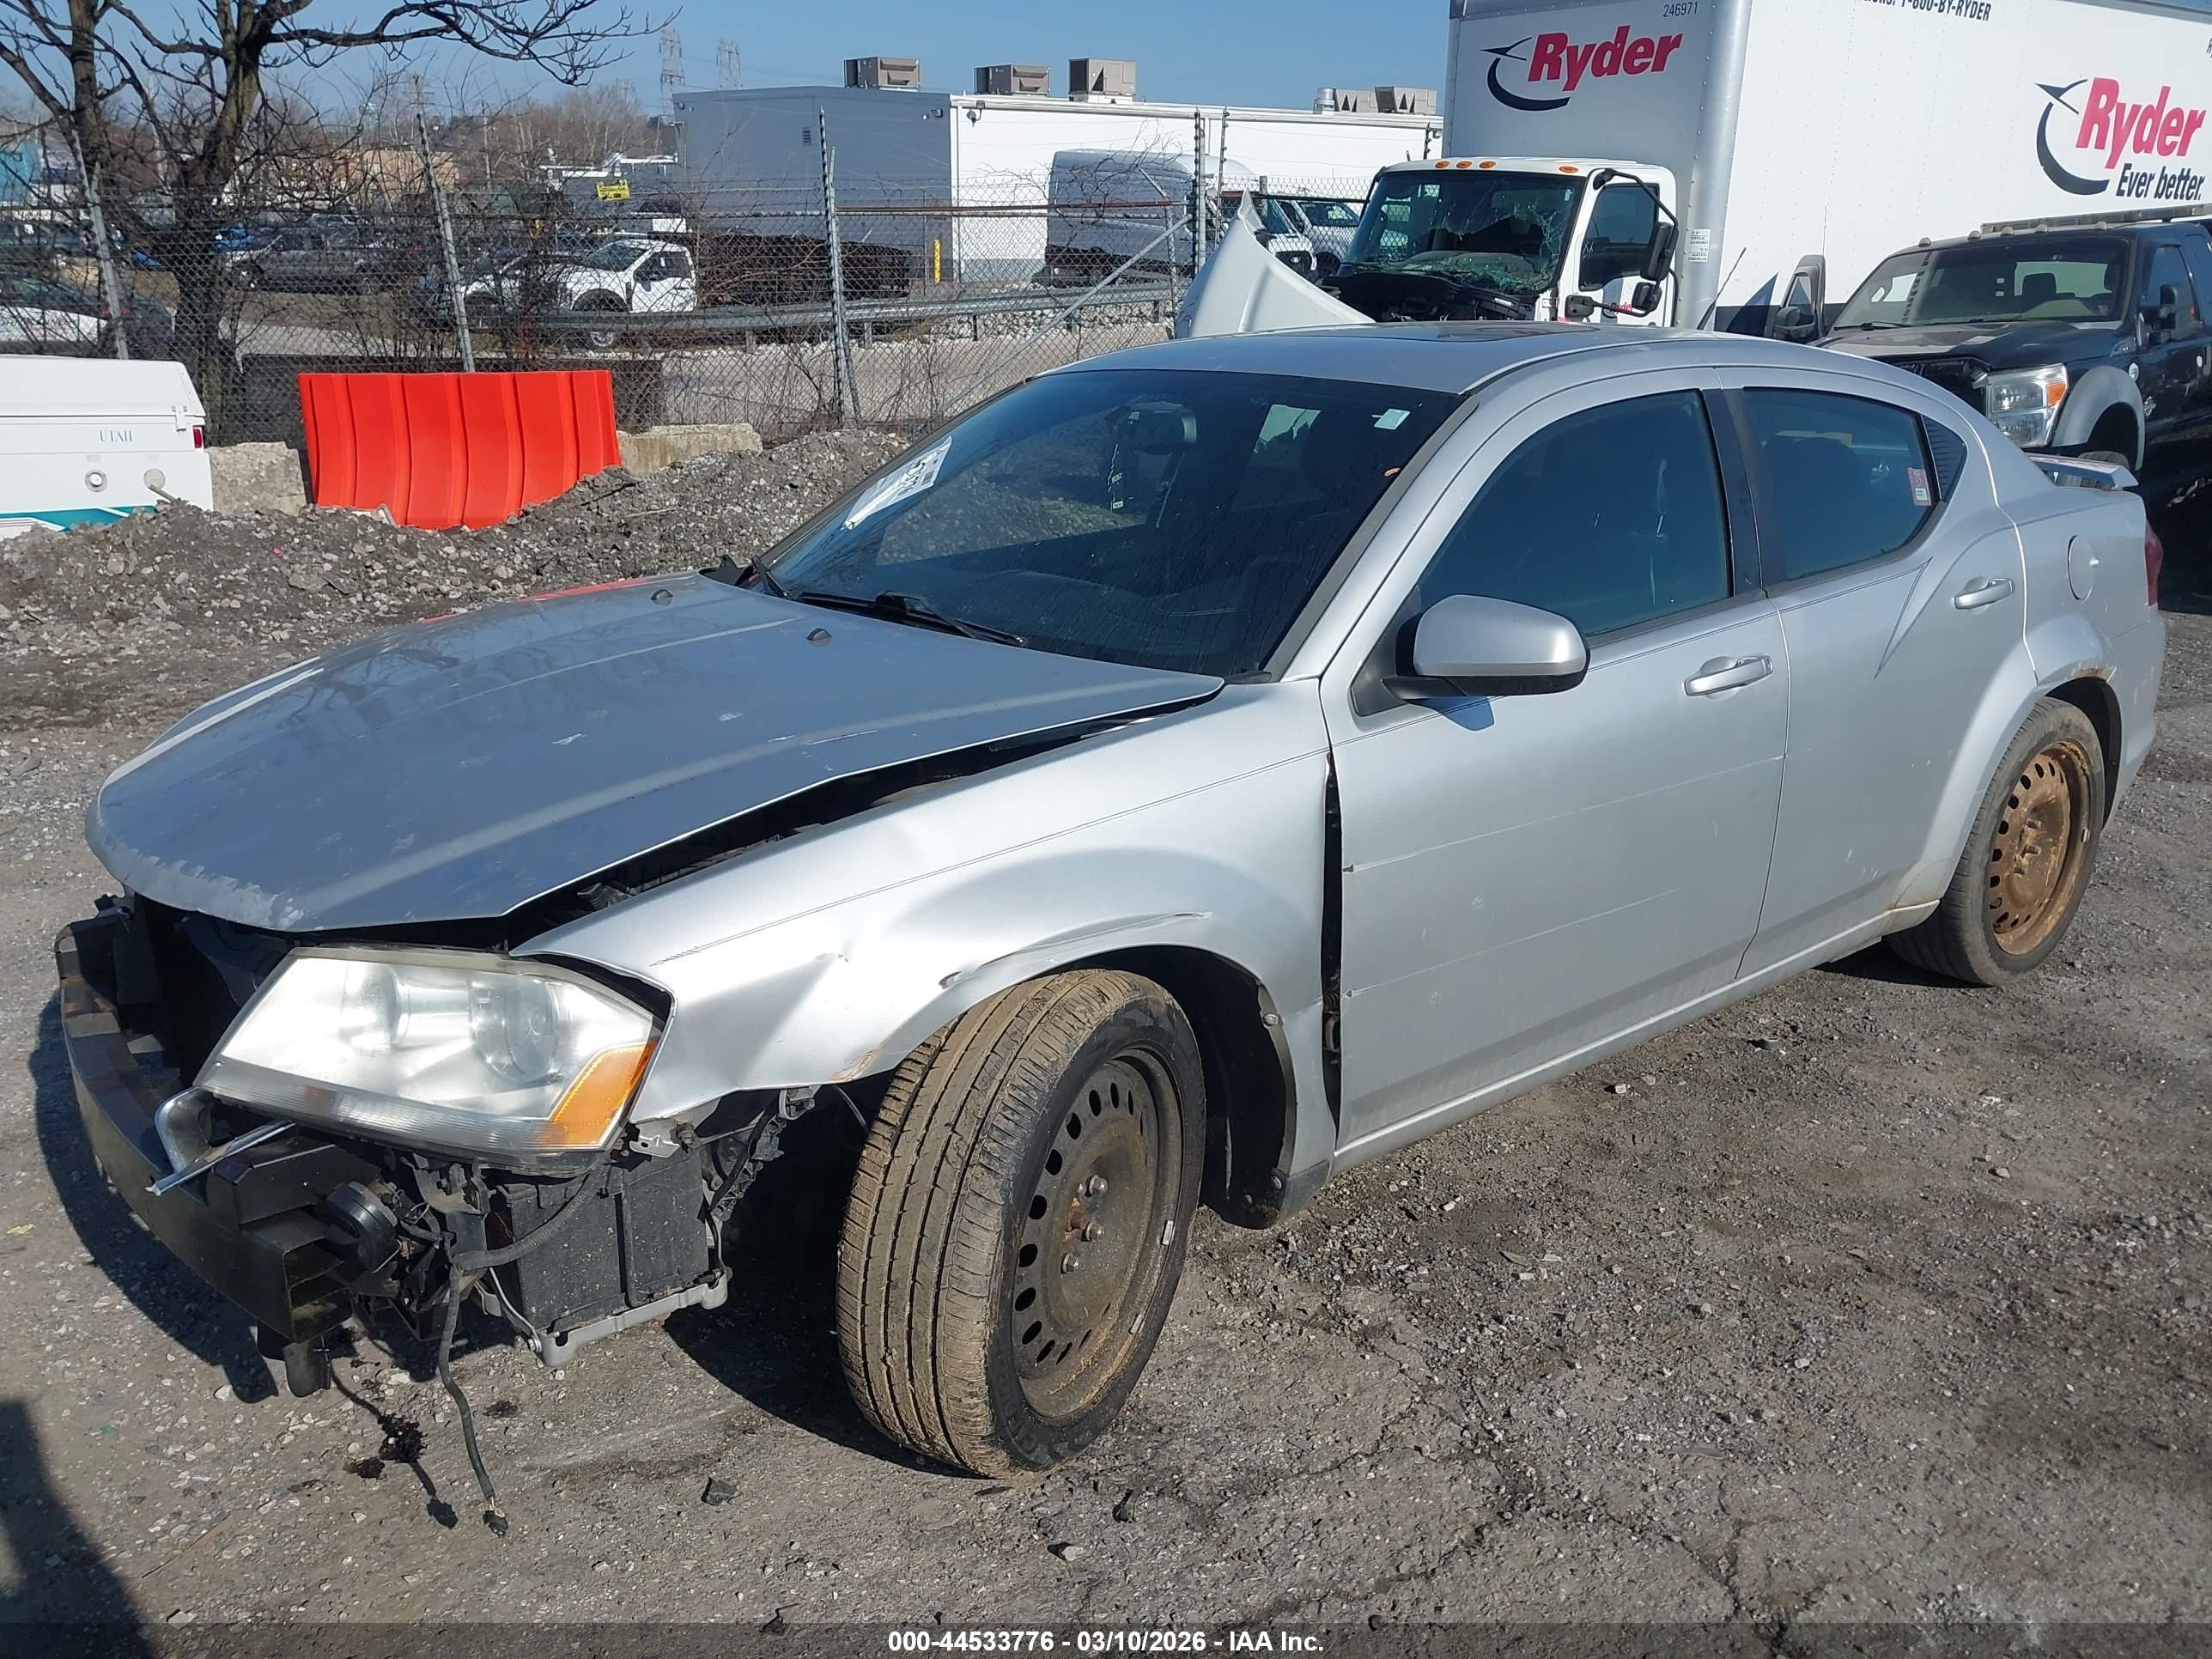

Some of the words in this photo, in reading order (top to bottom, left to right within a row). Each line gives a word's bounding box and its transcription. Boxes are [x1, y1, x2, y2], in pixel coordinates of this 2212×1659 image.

[1662, 1, 1698, 17] 246971
[1528, 25, 1684, 92] Ryder
[2075, 76, 2207, 169] Ryder
[2116, 163, 2155, 198] Ever
